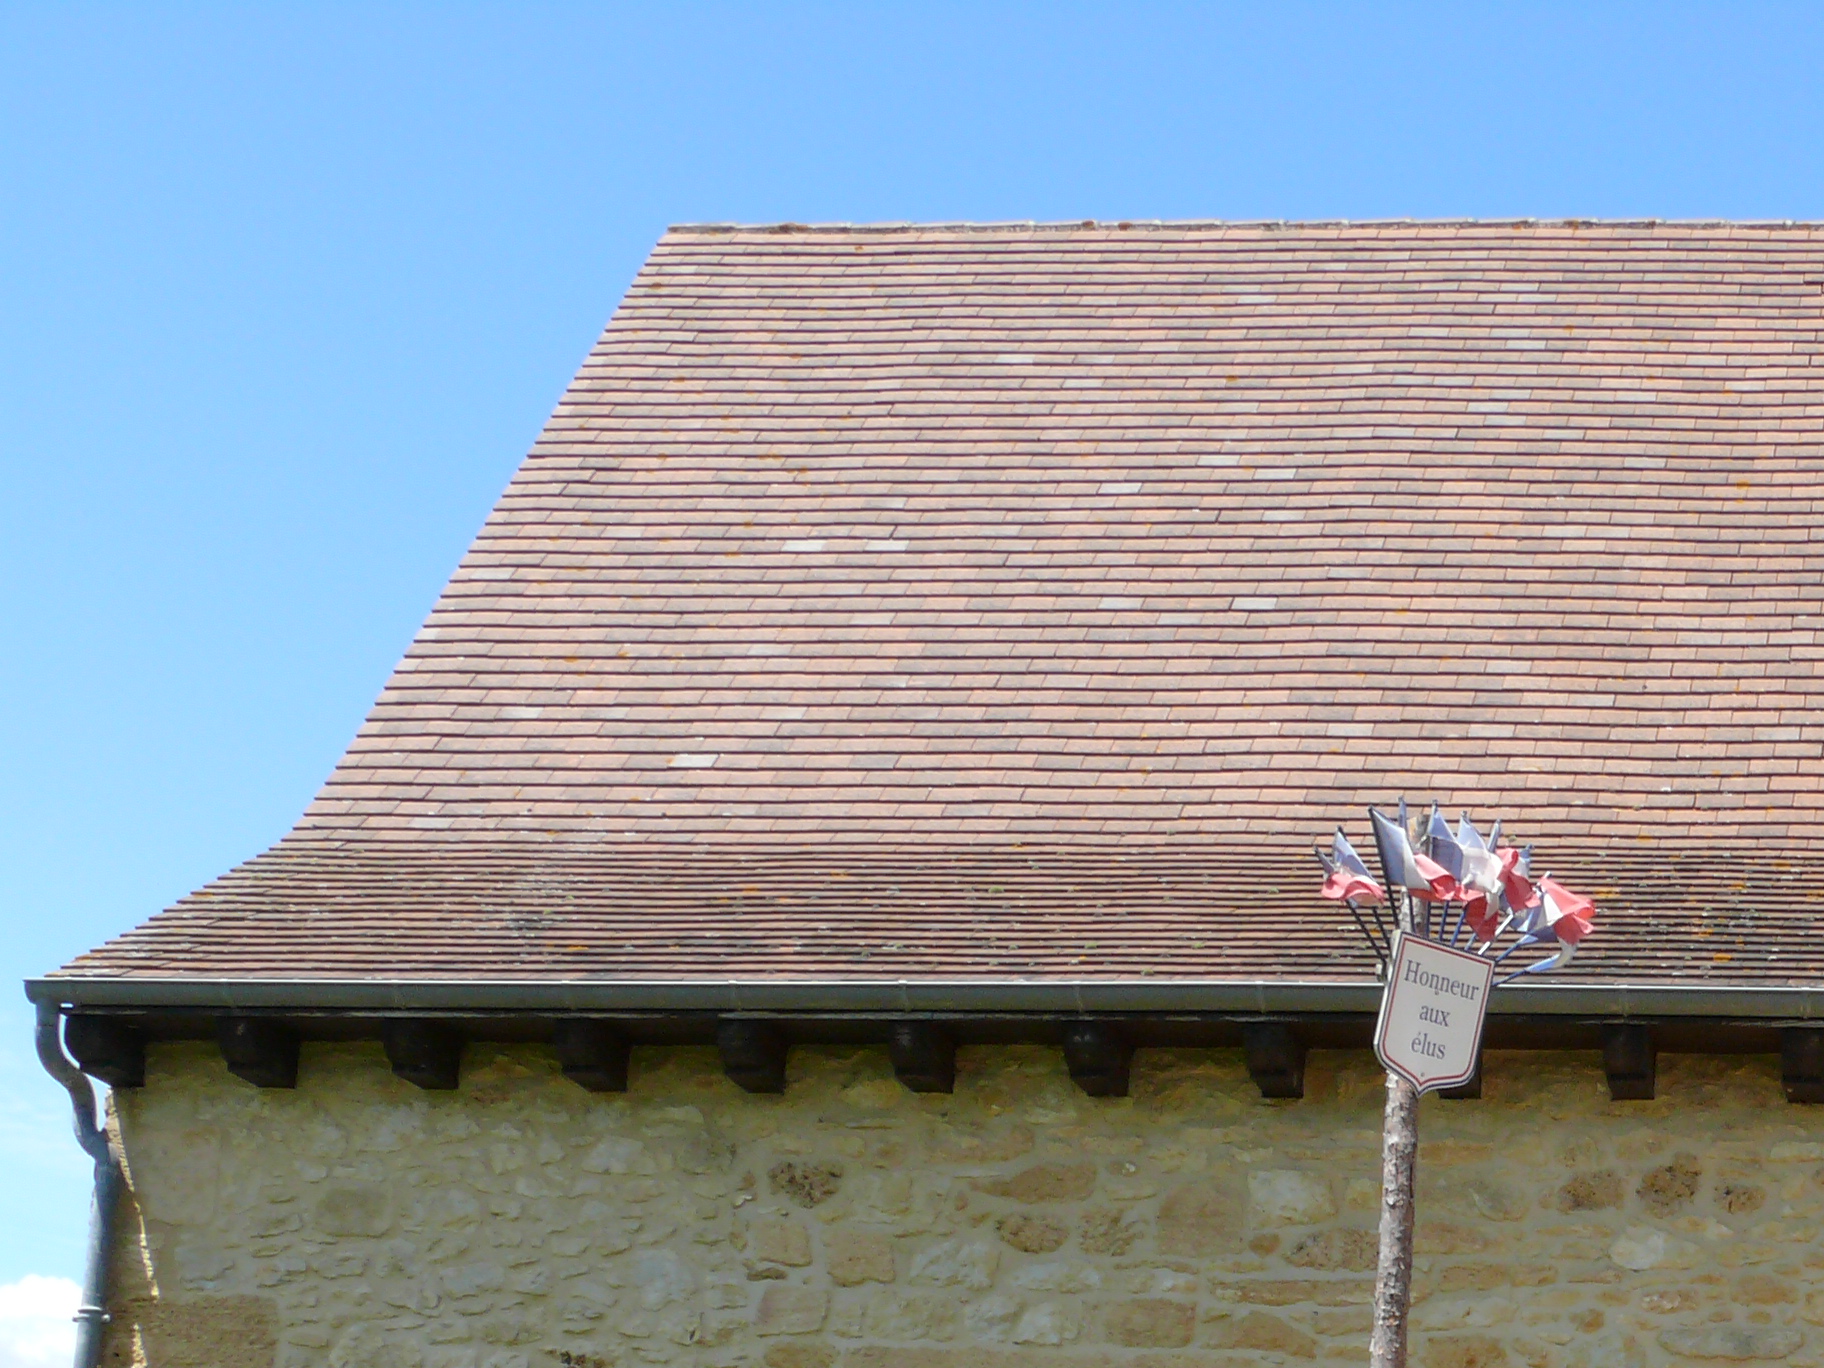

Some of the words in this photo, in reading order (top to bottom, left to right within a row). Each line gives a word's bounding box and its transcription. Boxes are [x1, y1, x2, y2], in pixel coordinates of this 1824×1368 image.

[1403, 959, 1480, 1000] Honneur
[1419, 1004, 1450, 1028] aux
[1411, 1031, 1446, 1060] élus
